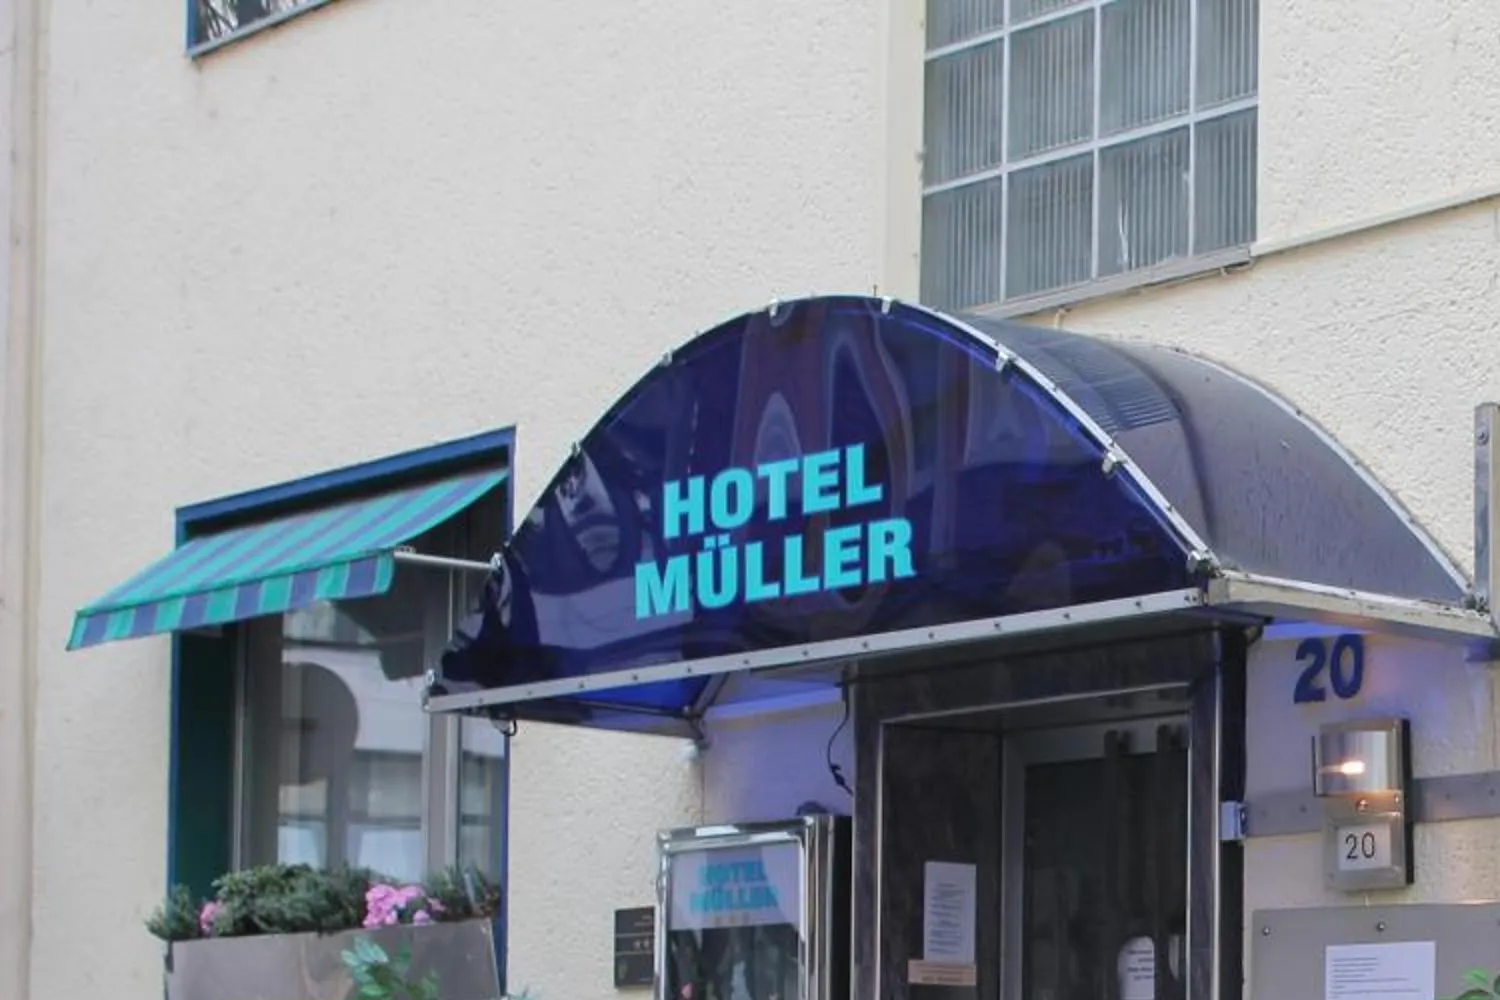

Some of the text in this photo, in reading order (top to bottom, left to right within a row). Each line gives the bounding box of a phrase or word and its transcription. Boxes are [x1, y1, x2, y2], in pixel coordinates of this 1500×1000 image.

[663, 442, 884, 540] HOTEL
[634, 516, 917, 620] MÜLLER
[1293, 633, 1366, 704] 20
[1345, 831, 1376, 860] 20
